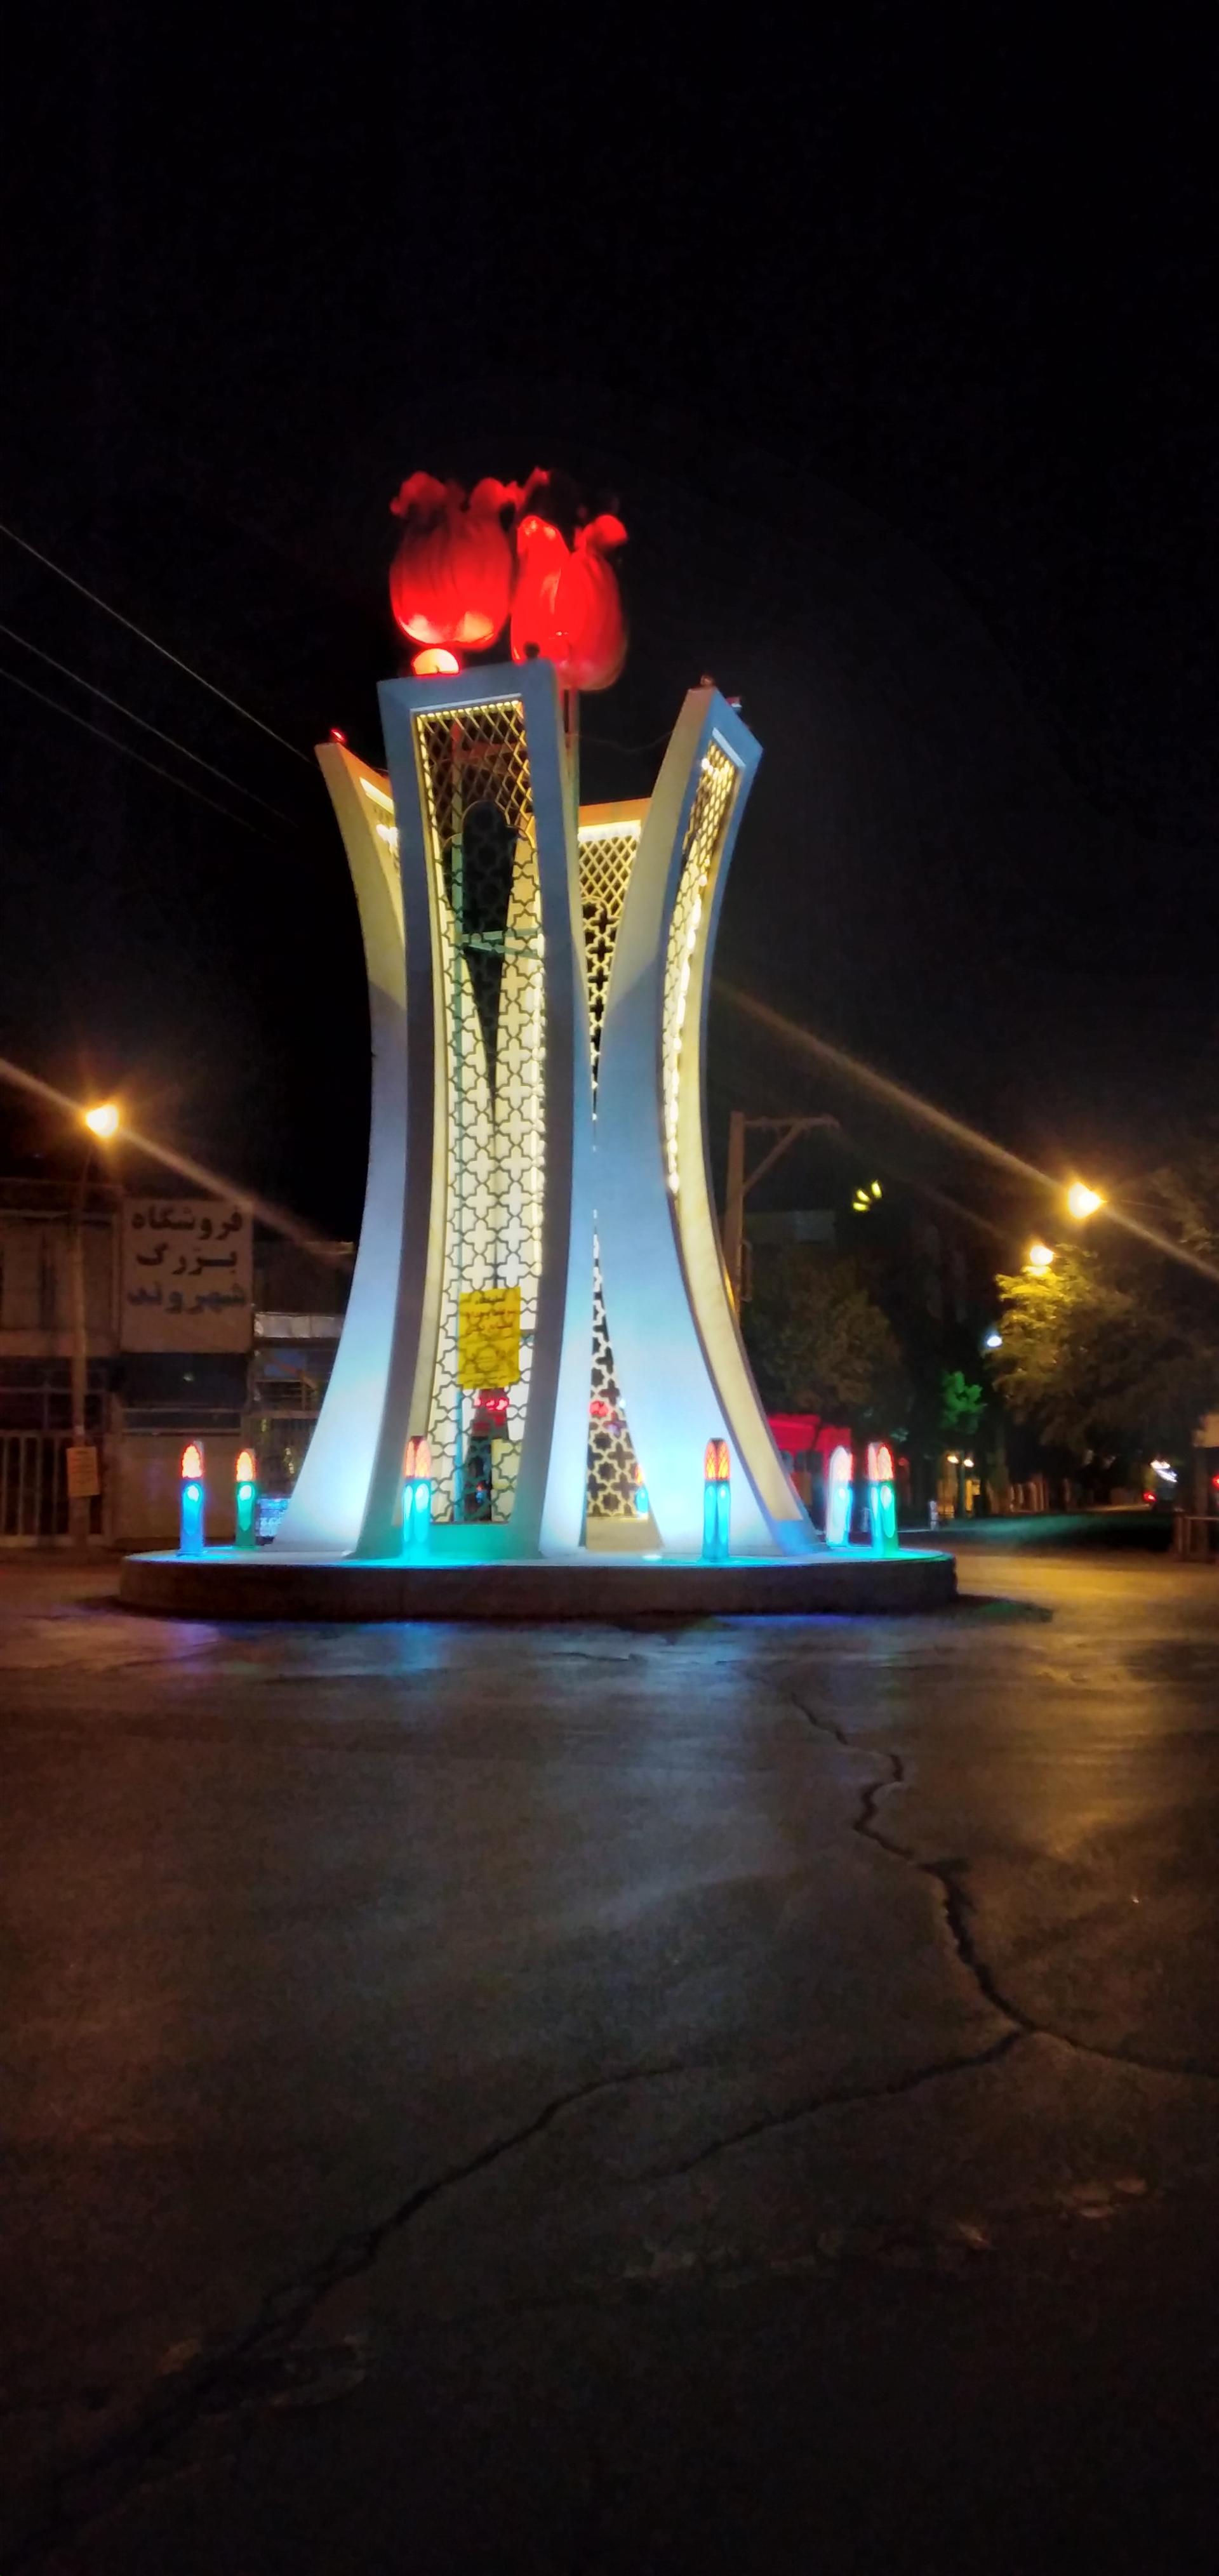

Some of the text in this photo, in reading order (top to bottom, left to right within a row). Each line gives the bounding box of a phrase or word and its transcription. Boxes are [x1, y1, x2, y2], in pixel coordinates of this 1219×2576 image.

[131, 1205, 243, 1240] فروشگاه
[137, 1242, 237, 1275] بزرگ
[128, 1282, 245, 1315] شهروند
